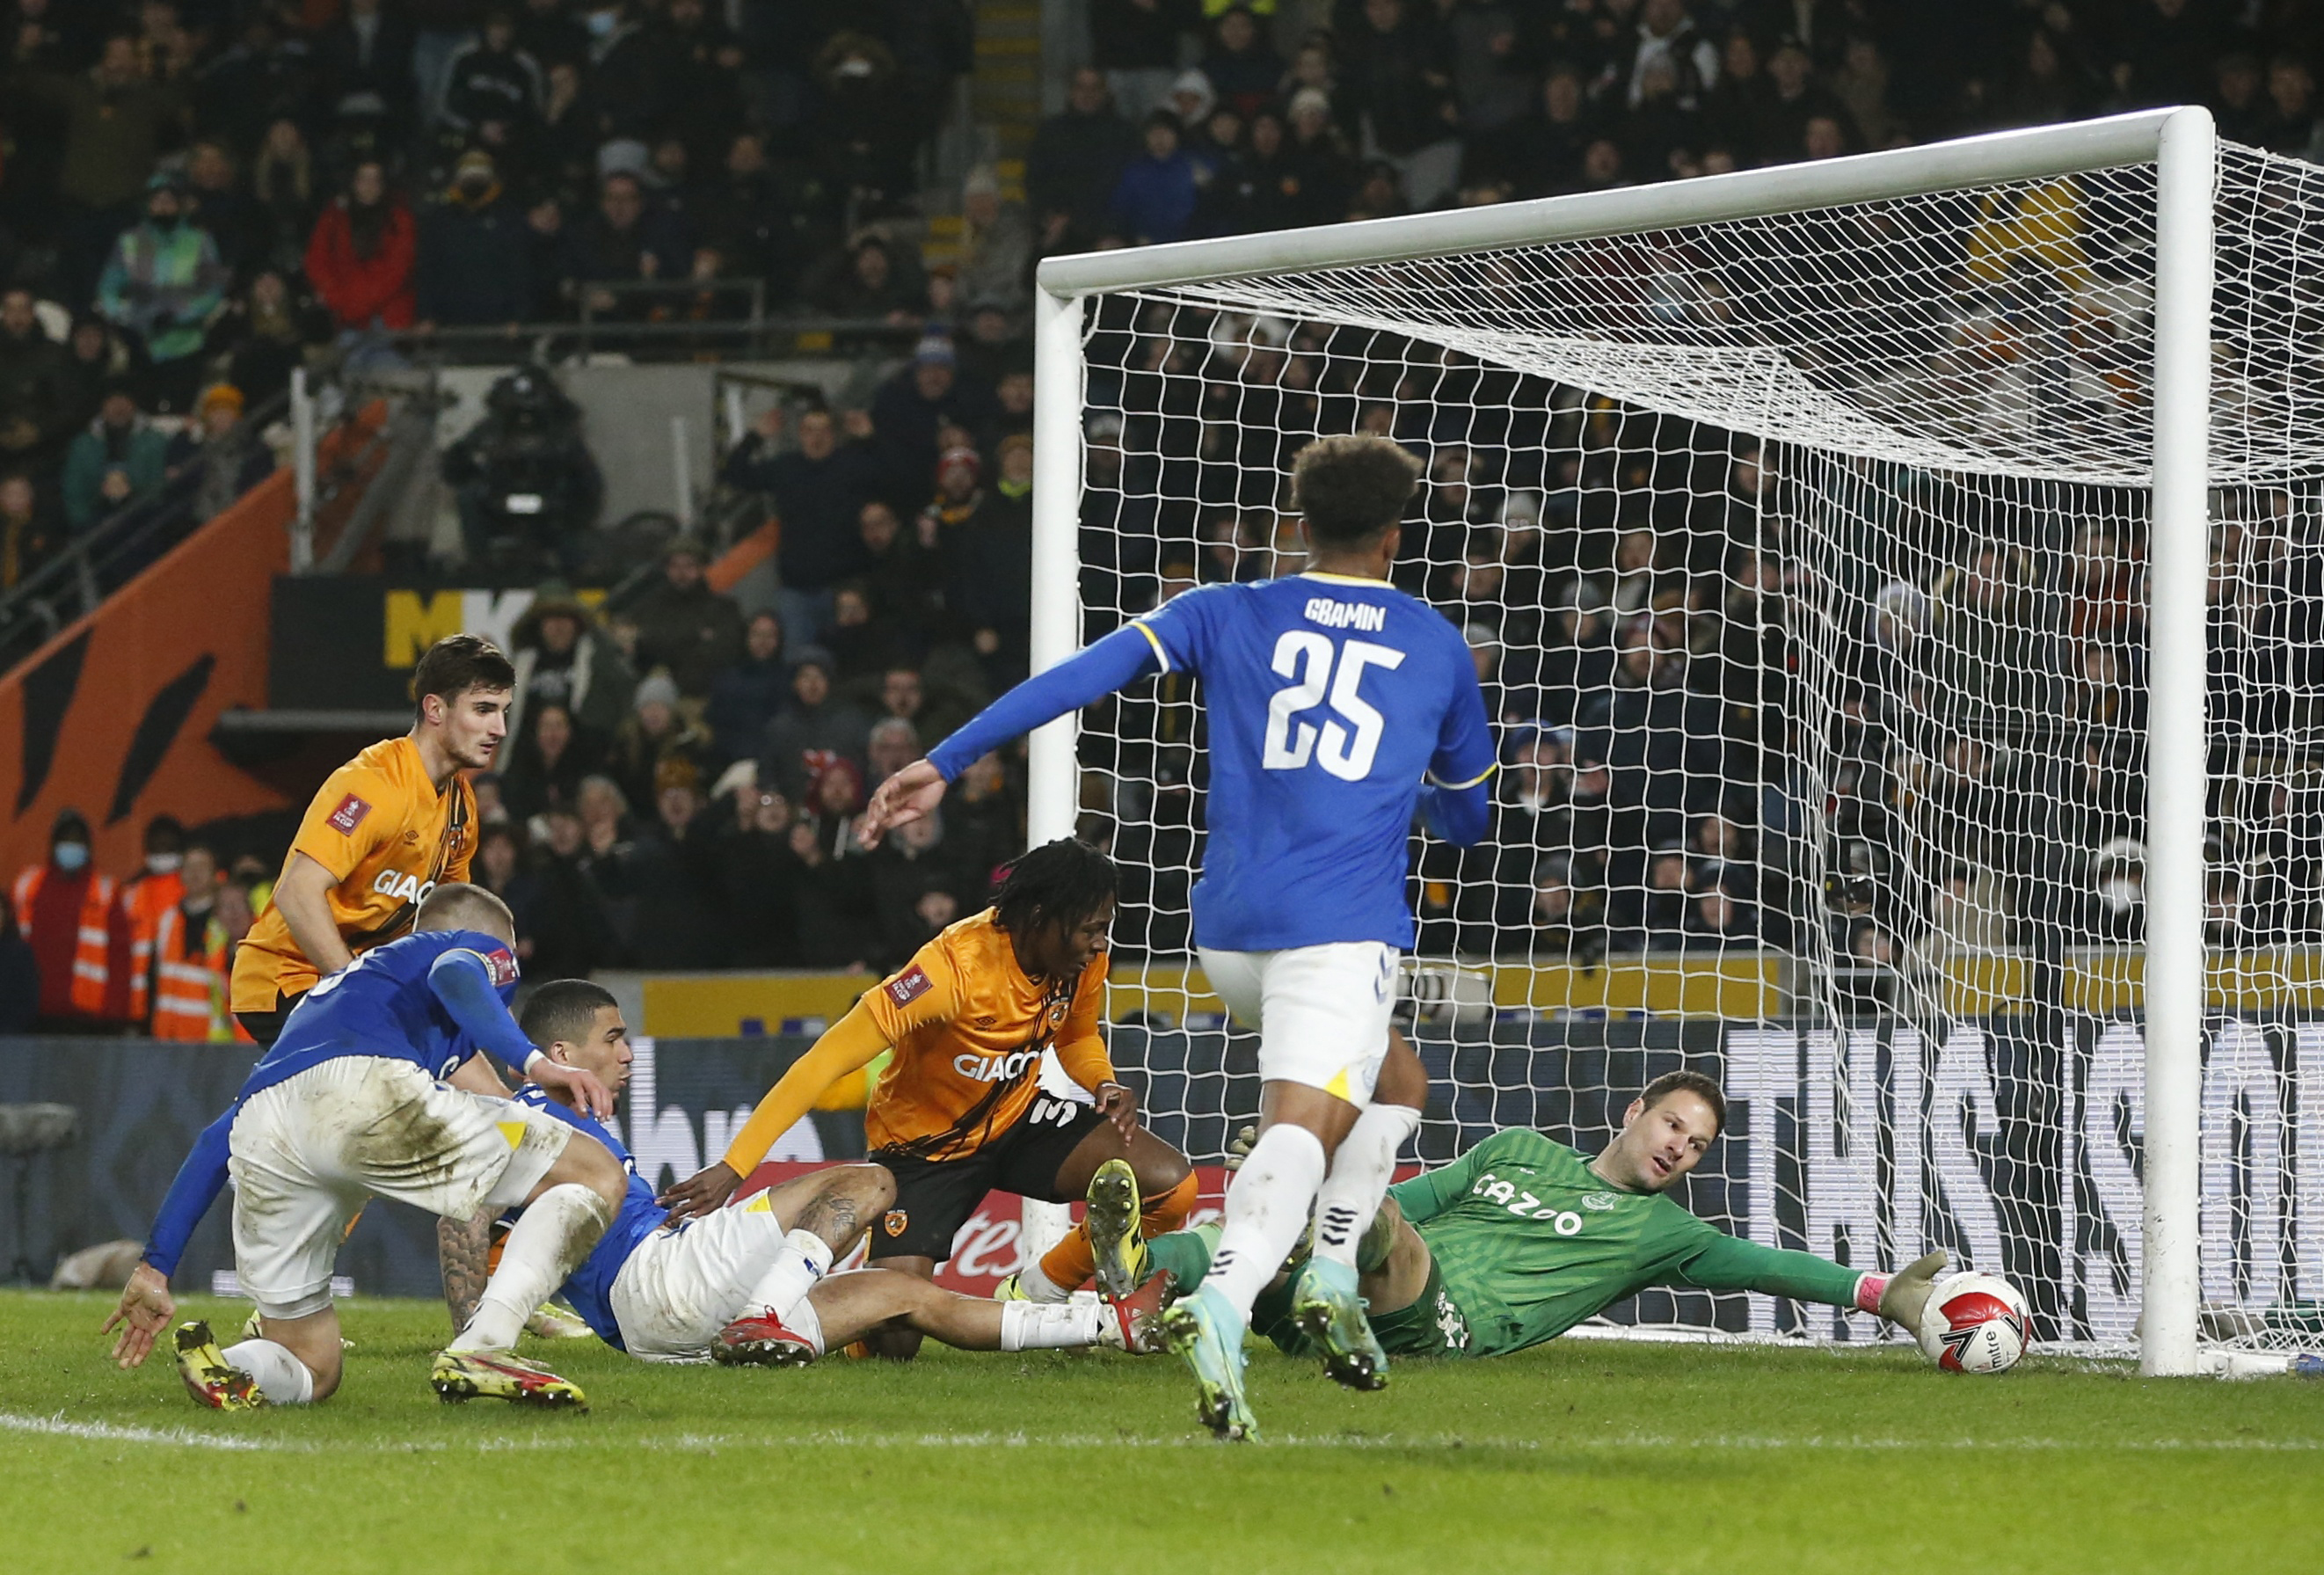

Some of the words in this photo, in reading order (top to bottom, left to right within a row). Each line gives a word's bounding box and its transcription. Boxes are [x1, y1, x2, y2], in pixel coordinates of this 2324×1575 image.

[384, 588, 608, 668] MK
[1304, 598, 1387, 631] GBAMIN
[1263, 630, 1406, 782] 25
[374, 869, 435, 905] GIAC
[1726, 1027, 2004, 1342] THIS
[1985, 1331, 2003, 1368] mitre
